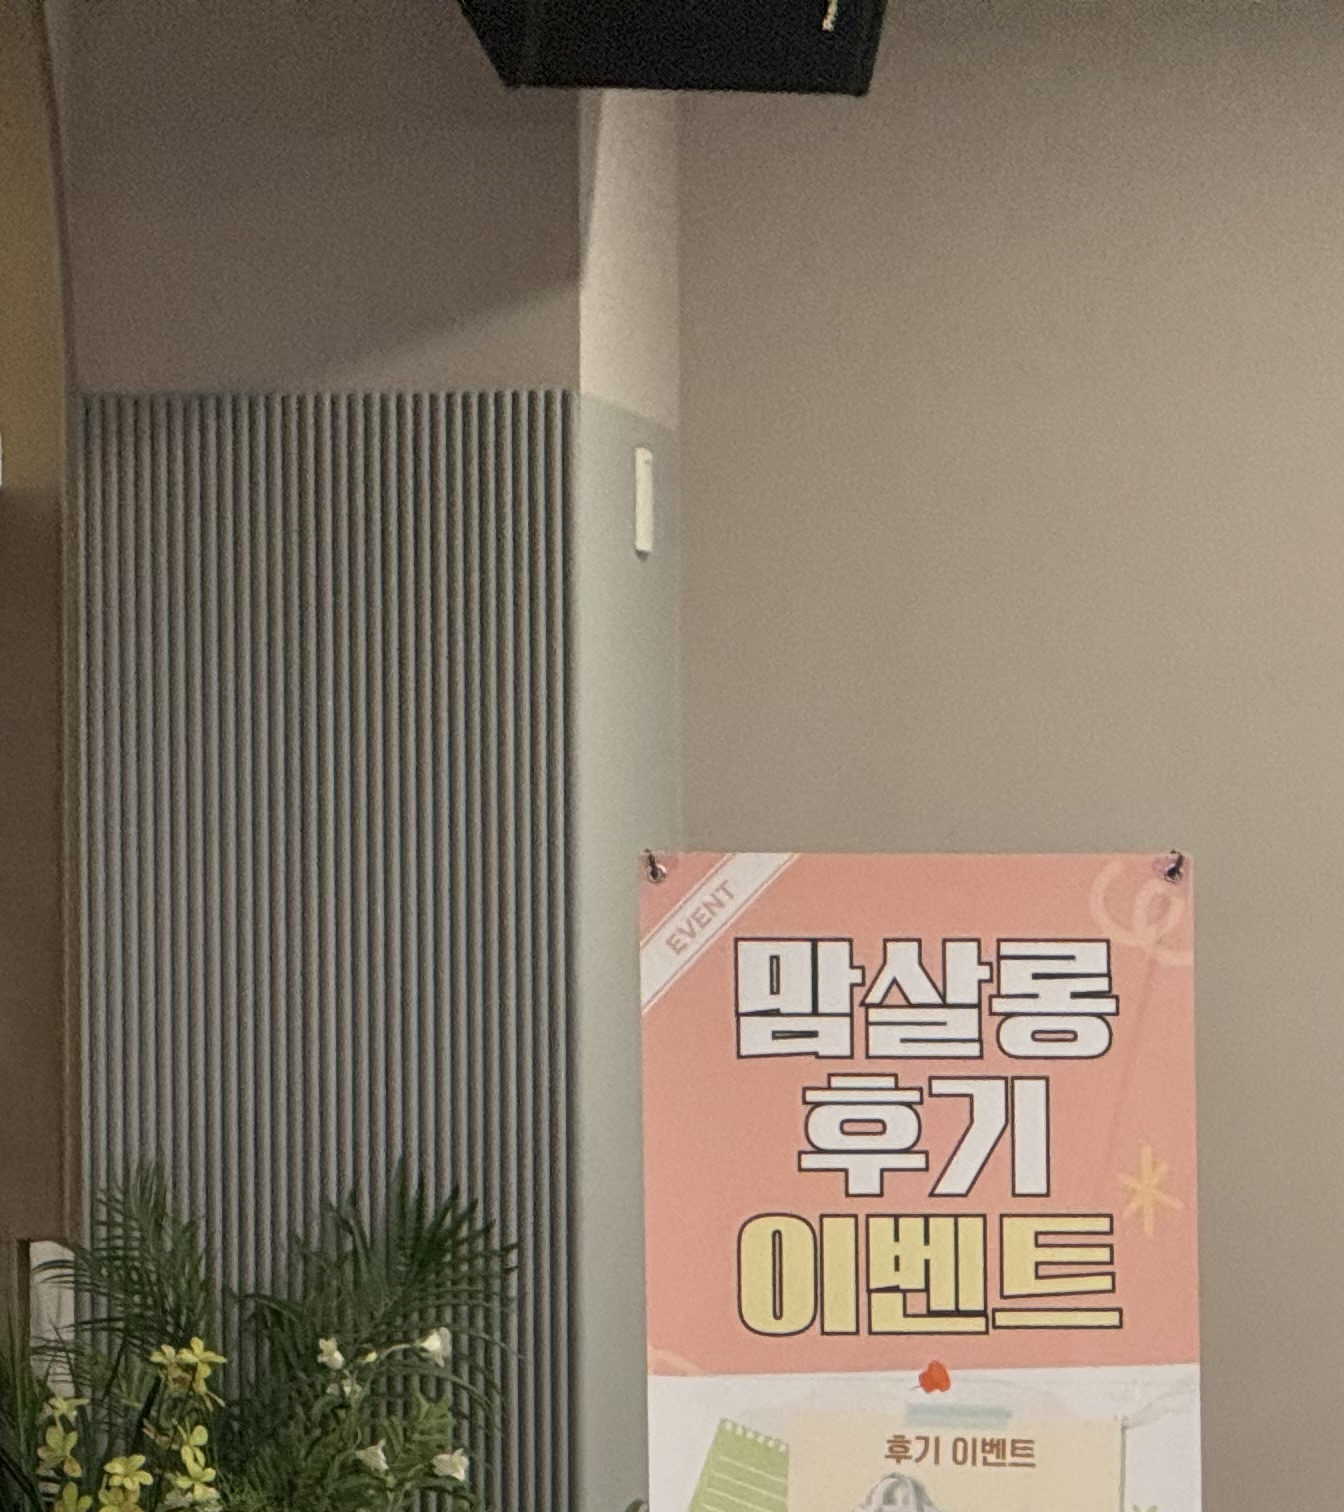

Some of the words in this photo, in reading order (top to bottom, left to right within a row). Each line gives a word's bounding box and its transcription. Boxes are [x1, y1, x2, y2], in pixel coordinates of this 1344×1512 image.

[665, 880, 734, 956] EVENT
[733, 936, 1120, 1060] 맘살롱
[797, 1072, 1051, 1198] 후기
[736, 1212, 1124, 1337] 이벤트
[884, 1434, 941, 1466] 후기
[951, 1436, 1037, 1467] 이벤트
